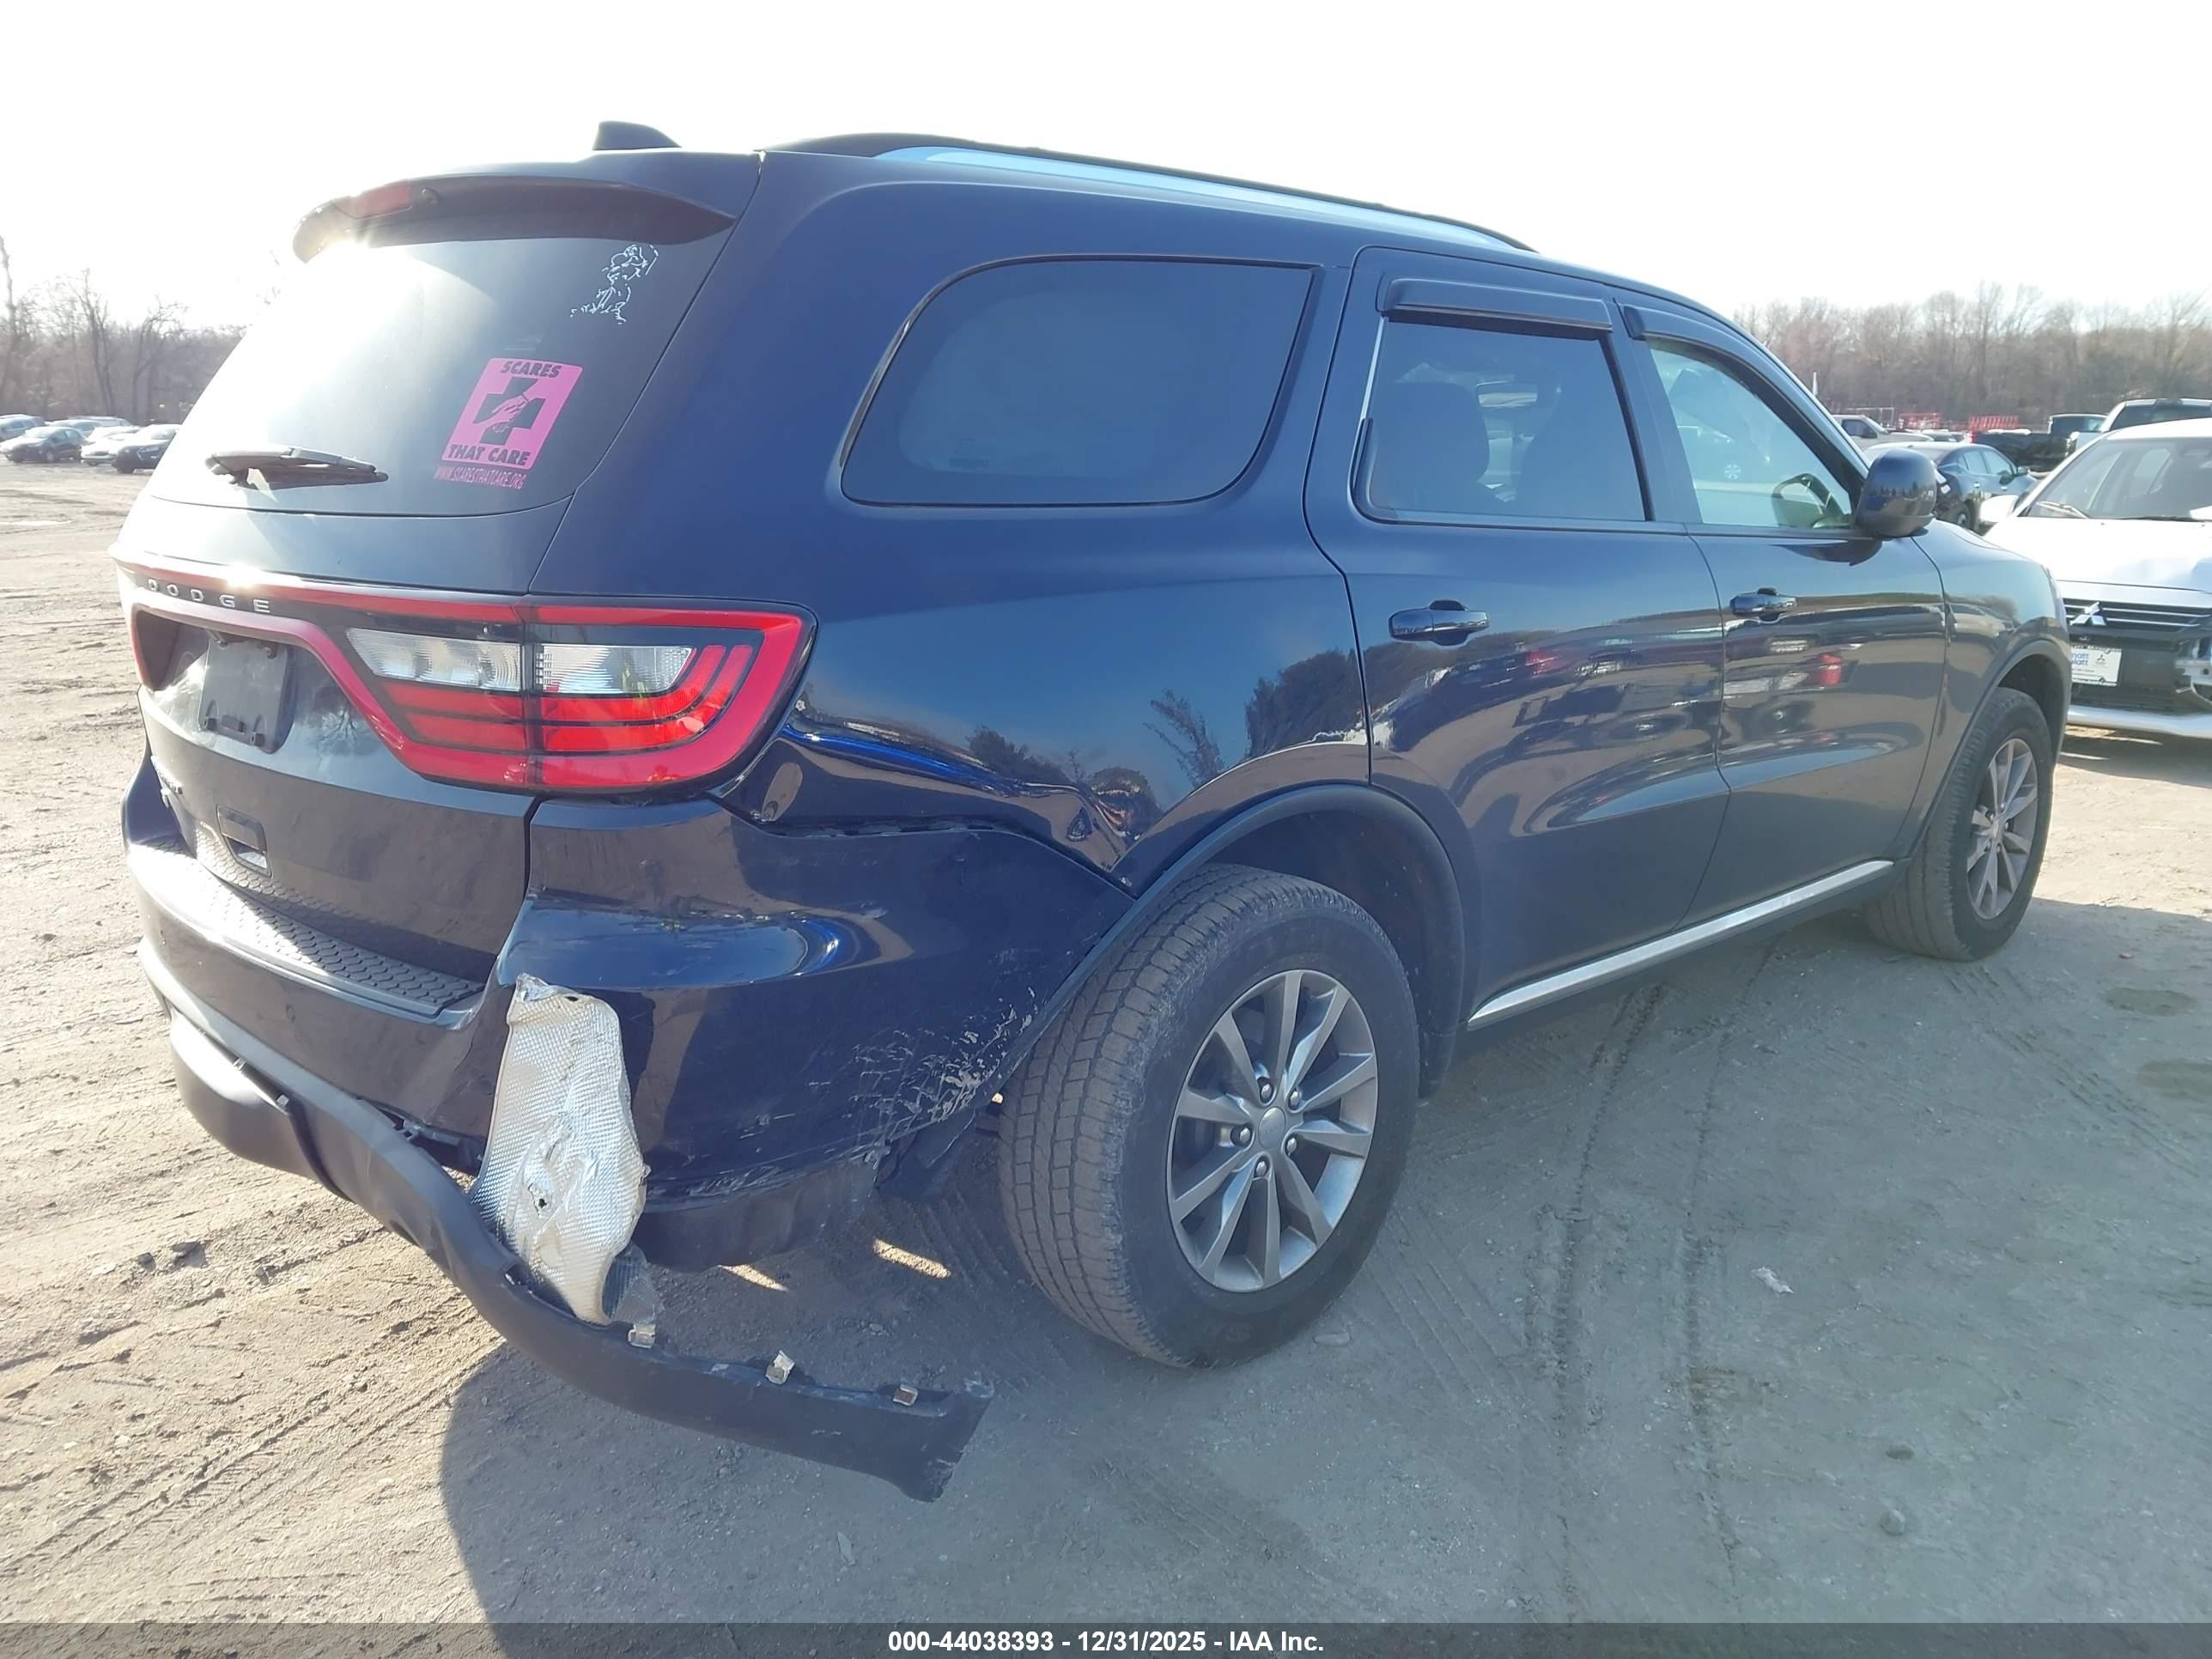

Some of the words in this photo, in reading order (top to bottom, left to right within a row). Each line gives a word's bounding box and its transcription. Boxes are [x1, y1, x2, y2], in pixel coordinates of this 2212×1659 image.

[501, 361, 562, 378] SCARES
[447, 444, 484, 460] THAT
[488, 448, 531, 466] CARE
[148, 579, 270, 613] DODGE
